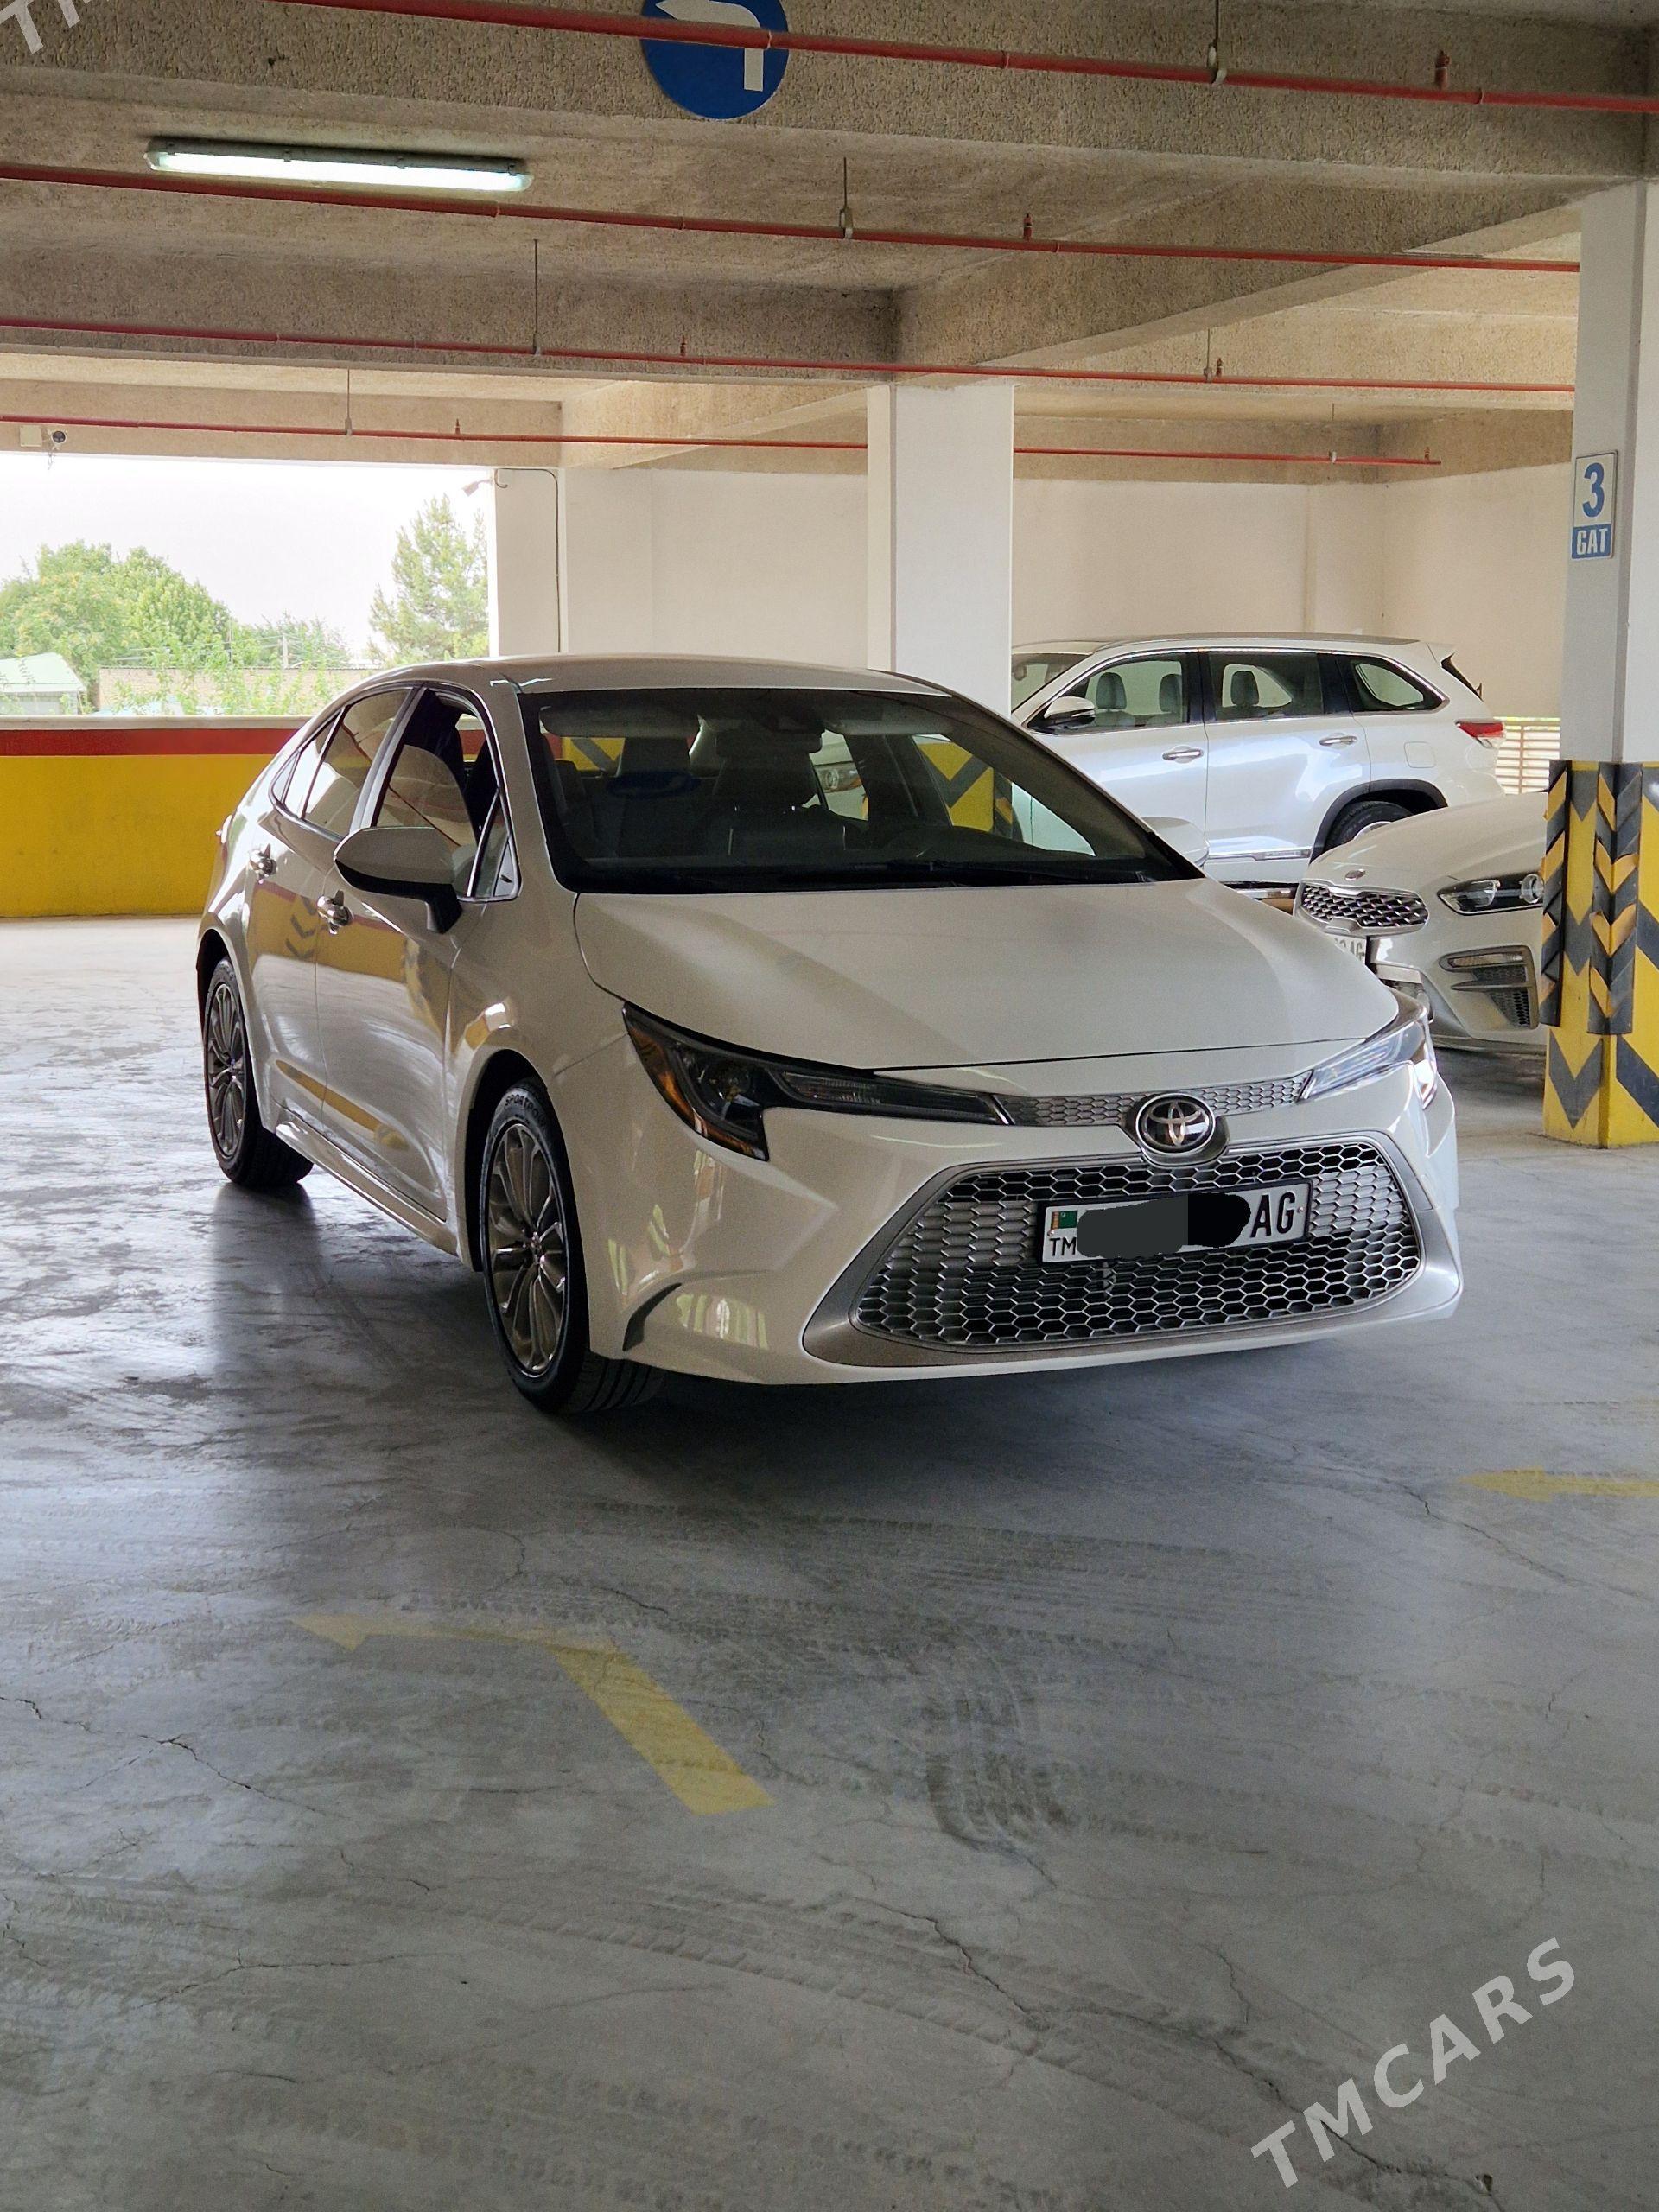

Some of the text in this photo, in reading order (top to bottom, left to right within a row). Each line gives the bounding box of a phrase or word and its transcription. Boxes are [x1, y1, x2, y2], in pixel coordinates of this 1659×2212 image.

[1582, 462, 1605, 518] 3
[1576, 528, 1608, 555] GAT
[1249, 1191, 1296, 1237] AG
[1049, 1236, 1077, 1256] TM
